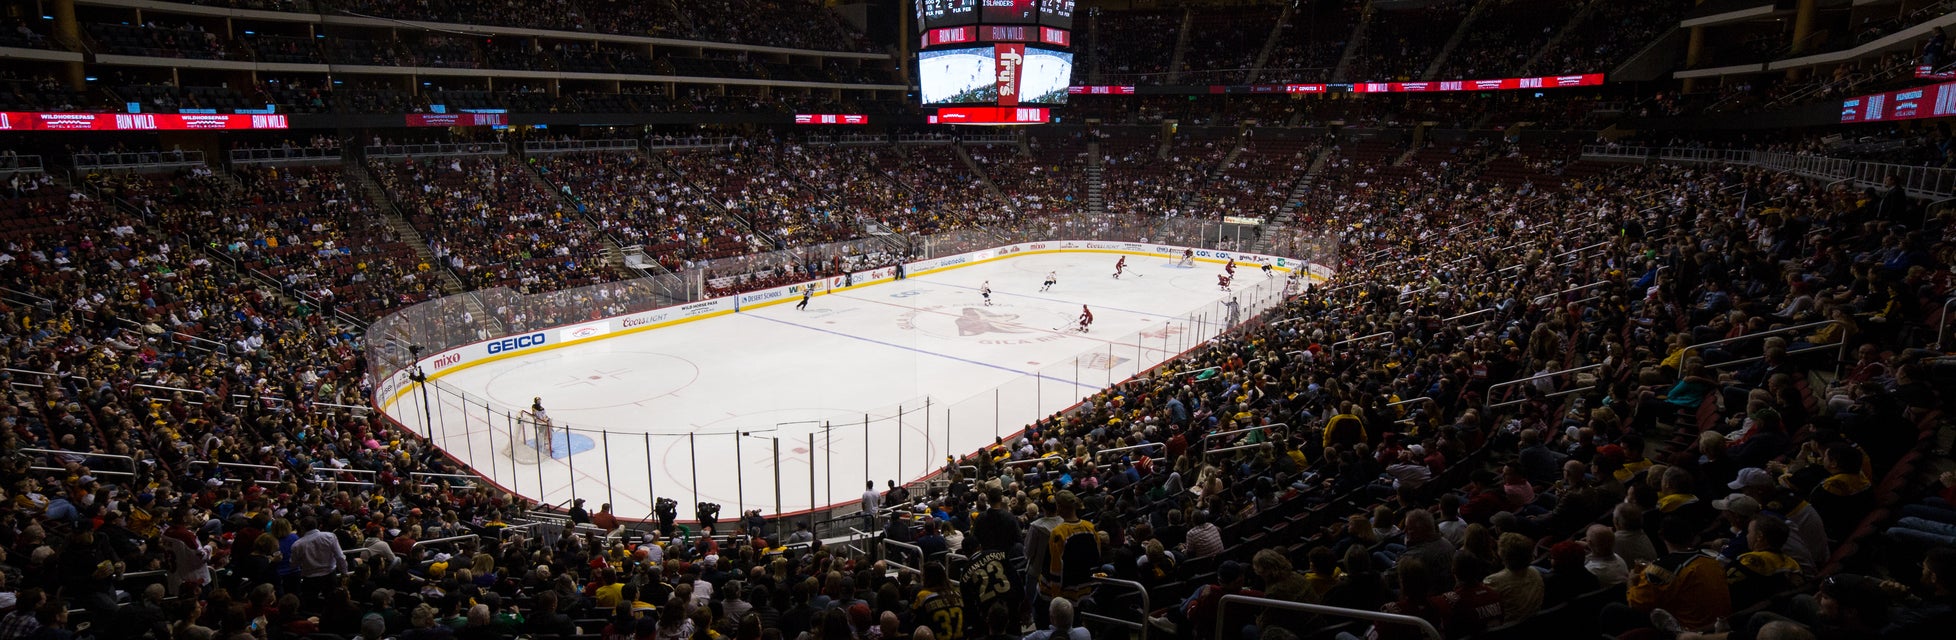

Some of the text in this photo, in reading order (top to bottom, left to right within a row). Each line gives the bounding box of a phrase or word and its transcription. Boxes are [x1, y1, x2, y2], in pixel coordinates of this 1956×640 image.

[939, 29, 950, 42] RUN
[992, 27, 1024, 40] RUN WILD.
[474, 114, 486, 126] RUN
[1016, 108, 1028, 121] RUN
[116, 114, 157, 129] RUN WILD.
[252, 115, 287, 129] RUN WILD.
[748, 290, 782, 302] DESERT SCHOOLS
[488, 333, 545, 354] GEICO
[972, 560, 1010, 602] 23
[932, 607, 963, 640] 37
